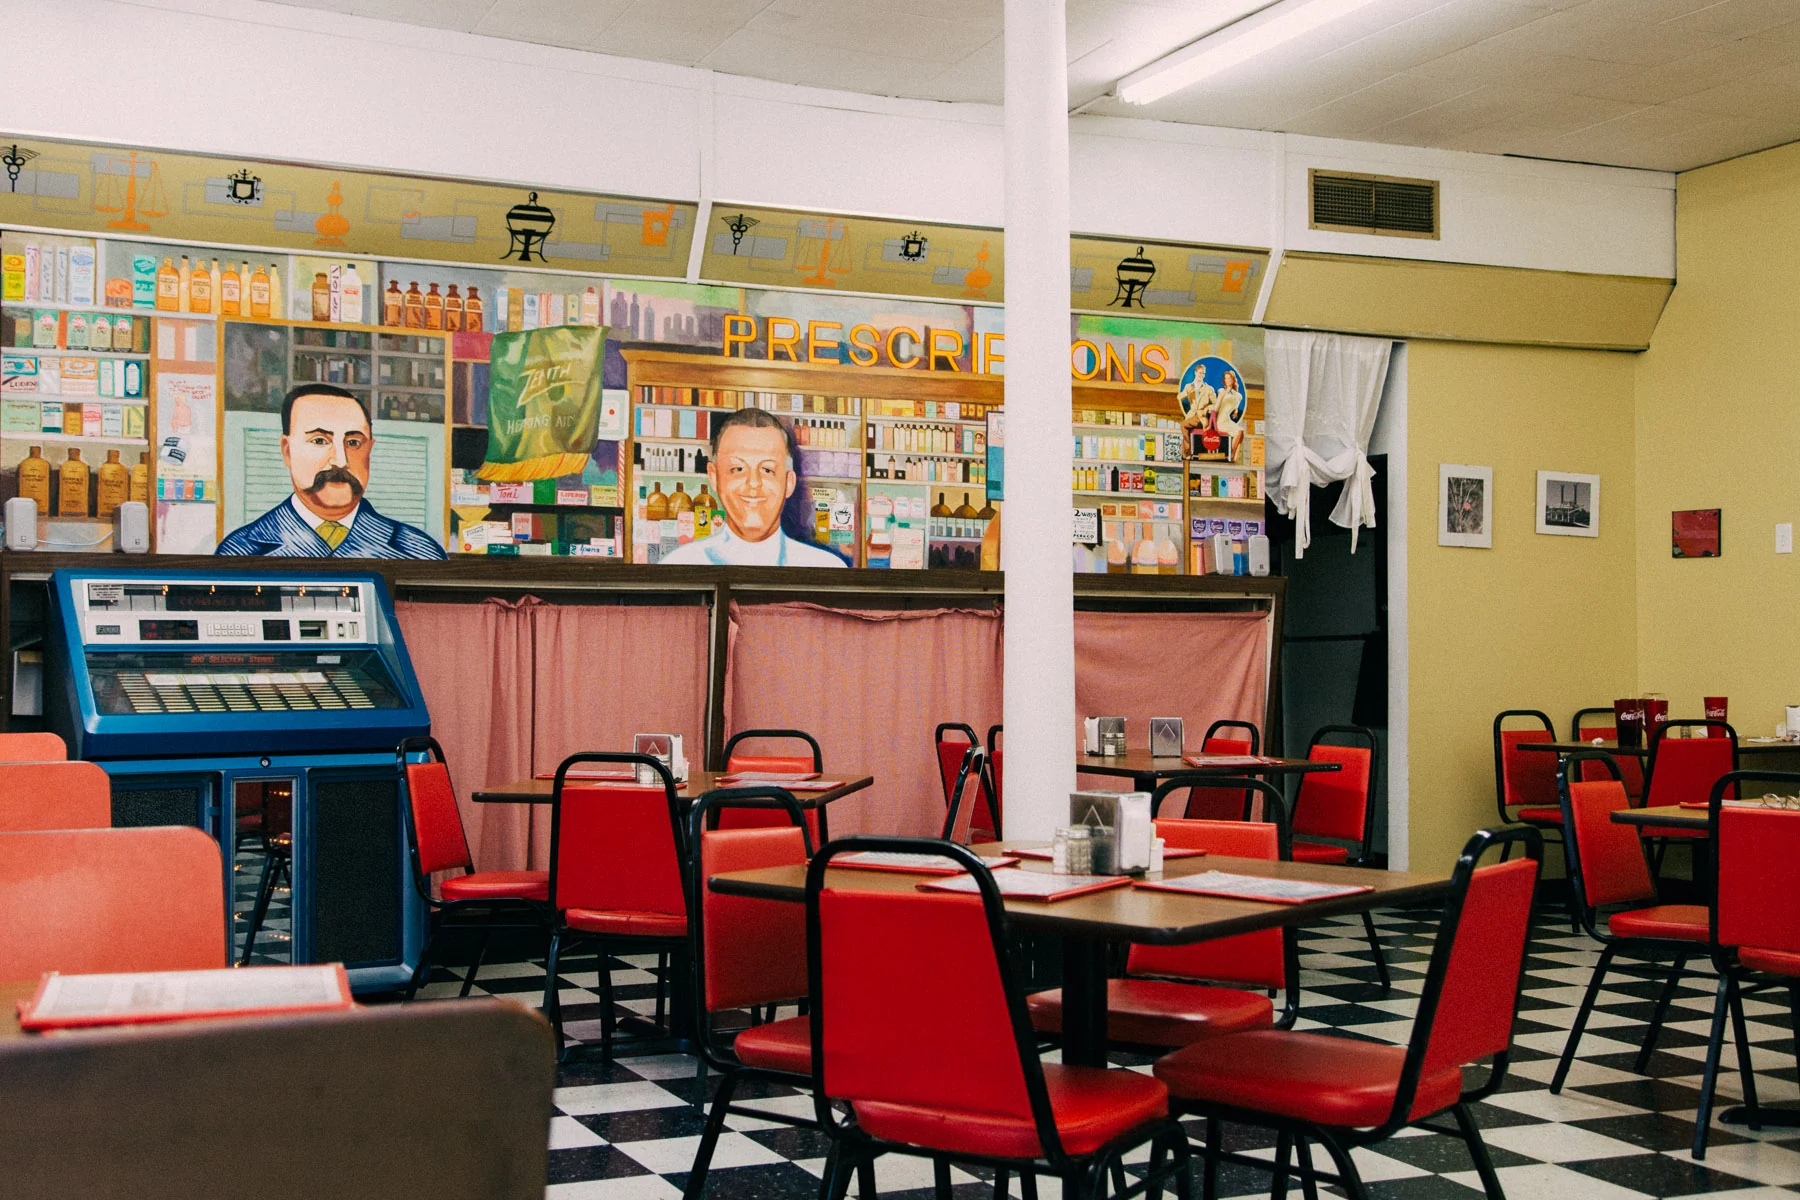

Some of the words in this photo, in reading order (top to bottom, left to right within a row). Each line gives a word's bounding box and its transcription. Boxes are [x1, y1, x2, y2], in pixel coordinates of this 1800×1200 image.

[722, 313, 1170, 384] PRESCRIPONS
[516, 364, 572, 408] ZENITH
[497, 488, 519, 499] Toni
[1074, 508, 1081, 517] 2
